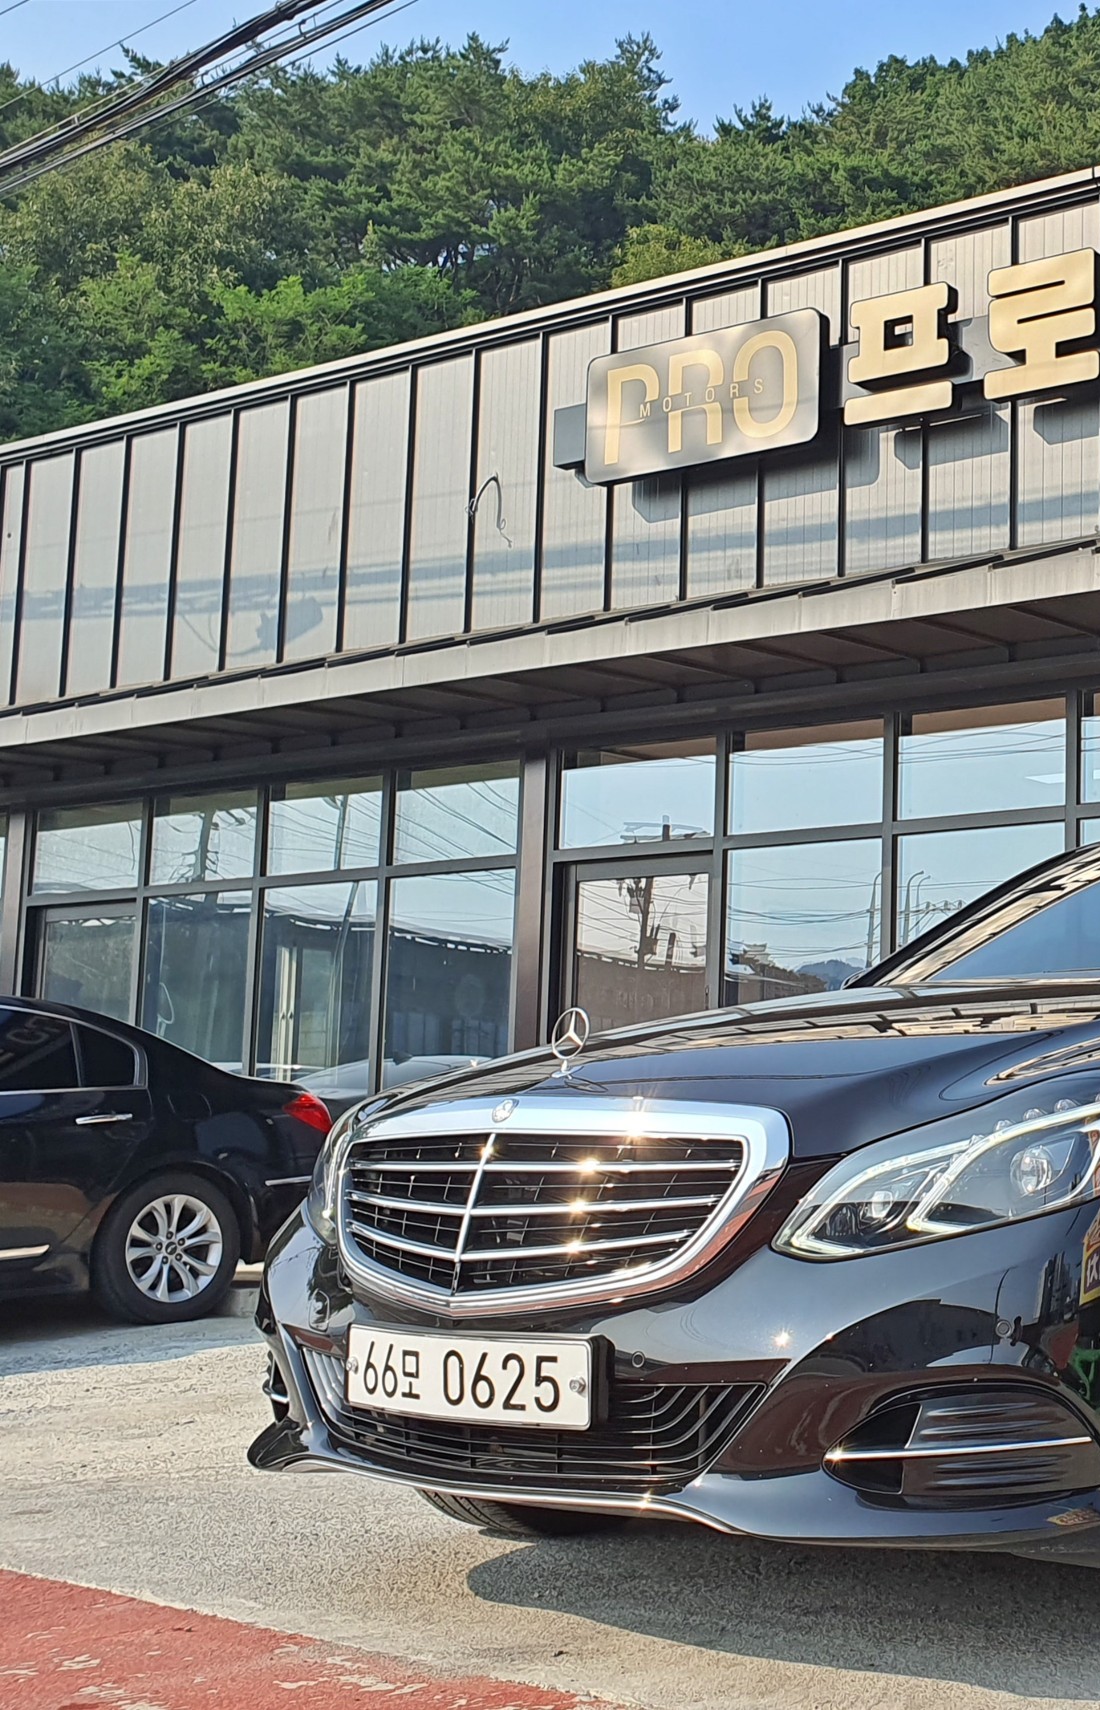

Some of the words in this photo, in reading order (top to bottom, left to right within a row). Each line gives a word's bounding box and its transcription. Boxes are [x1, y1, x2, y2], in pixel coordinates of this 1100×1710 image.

[604, 329, 798, 466] PRO
[639, 378, 764, 419] MOTORS
[363, 1340, 421, 1400] 66모
[442, 1349, 561, 1413] 0625
